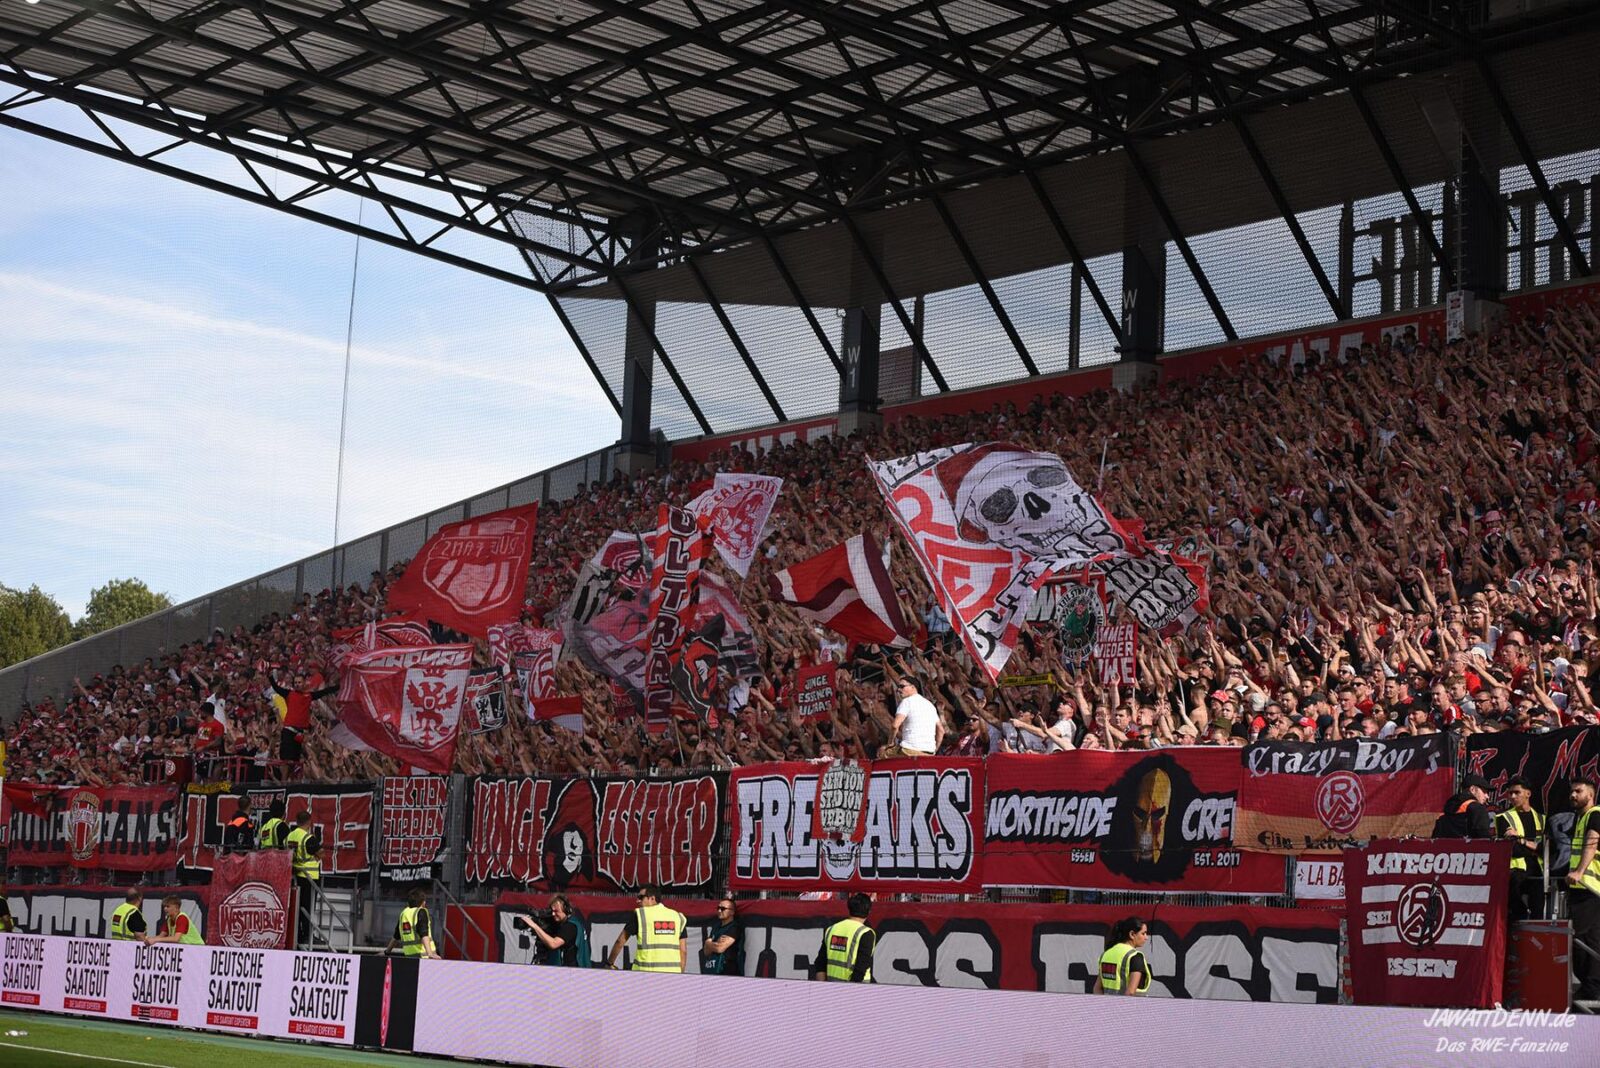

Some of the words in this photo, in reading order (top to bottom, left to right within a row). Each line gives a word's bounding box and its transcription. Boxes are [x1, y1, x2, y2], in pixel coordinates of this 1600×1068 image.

[1123, 288, 1138, 307] W
[1126, 313, 1133, 336] 1
[847, 345, 861, 364] W
[849, 368, 856, 388] 1
[383, 776, 449, 808] SEKTION
[382, 807, 448, 838] STADION
[465, 777, 552, 884] JUNGE
[598, 776, 719, 888] ESSENER
[984, 794, 1117, 841] NORTHSIDE
[1181, 796, 1238, 843] CRE
[1071, 850, 1095, 864] ESSEN
[1194, 852, 1215, 866] EST.
[1217, 852, 1241, 867] 2011
[1367, 852, 1490, 876] KATEGORIE
[1308, 865, 1324, 886] LA
[1452, 912, 1485, 926] 2015
[4, 937, 45, 962] DEUTSCHE
[67, 940, 111, 967] DEUTSCHE
[134, 945, 184, 973] DEUTSCHE
[2, 962, 43, 991] SAATGUT
[210, 950, 264, 979] DEUTSCHE
[292, 955, 351, 986] DEUTSCHE
[1387, 958, 1457, 978] ESSEN
[64, 967, 109, 998] SAATGUT
[132, 973, 182, 1006] SAATGUT
[207, 979, 262, 1013] SAATGUT
[289, 985, 348, 1022] SAATGUT
[303, 1024, 318, 1034] SAATGUT
[318, 1025, 337, 1036] EXPERTEN
